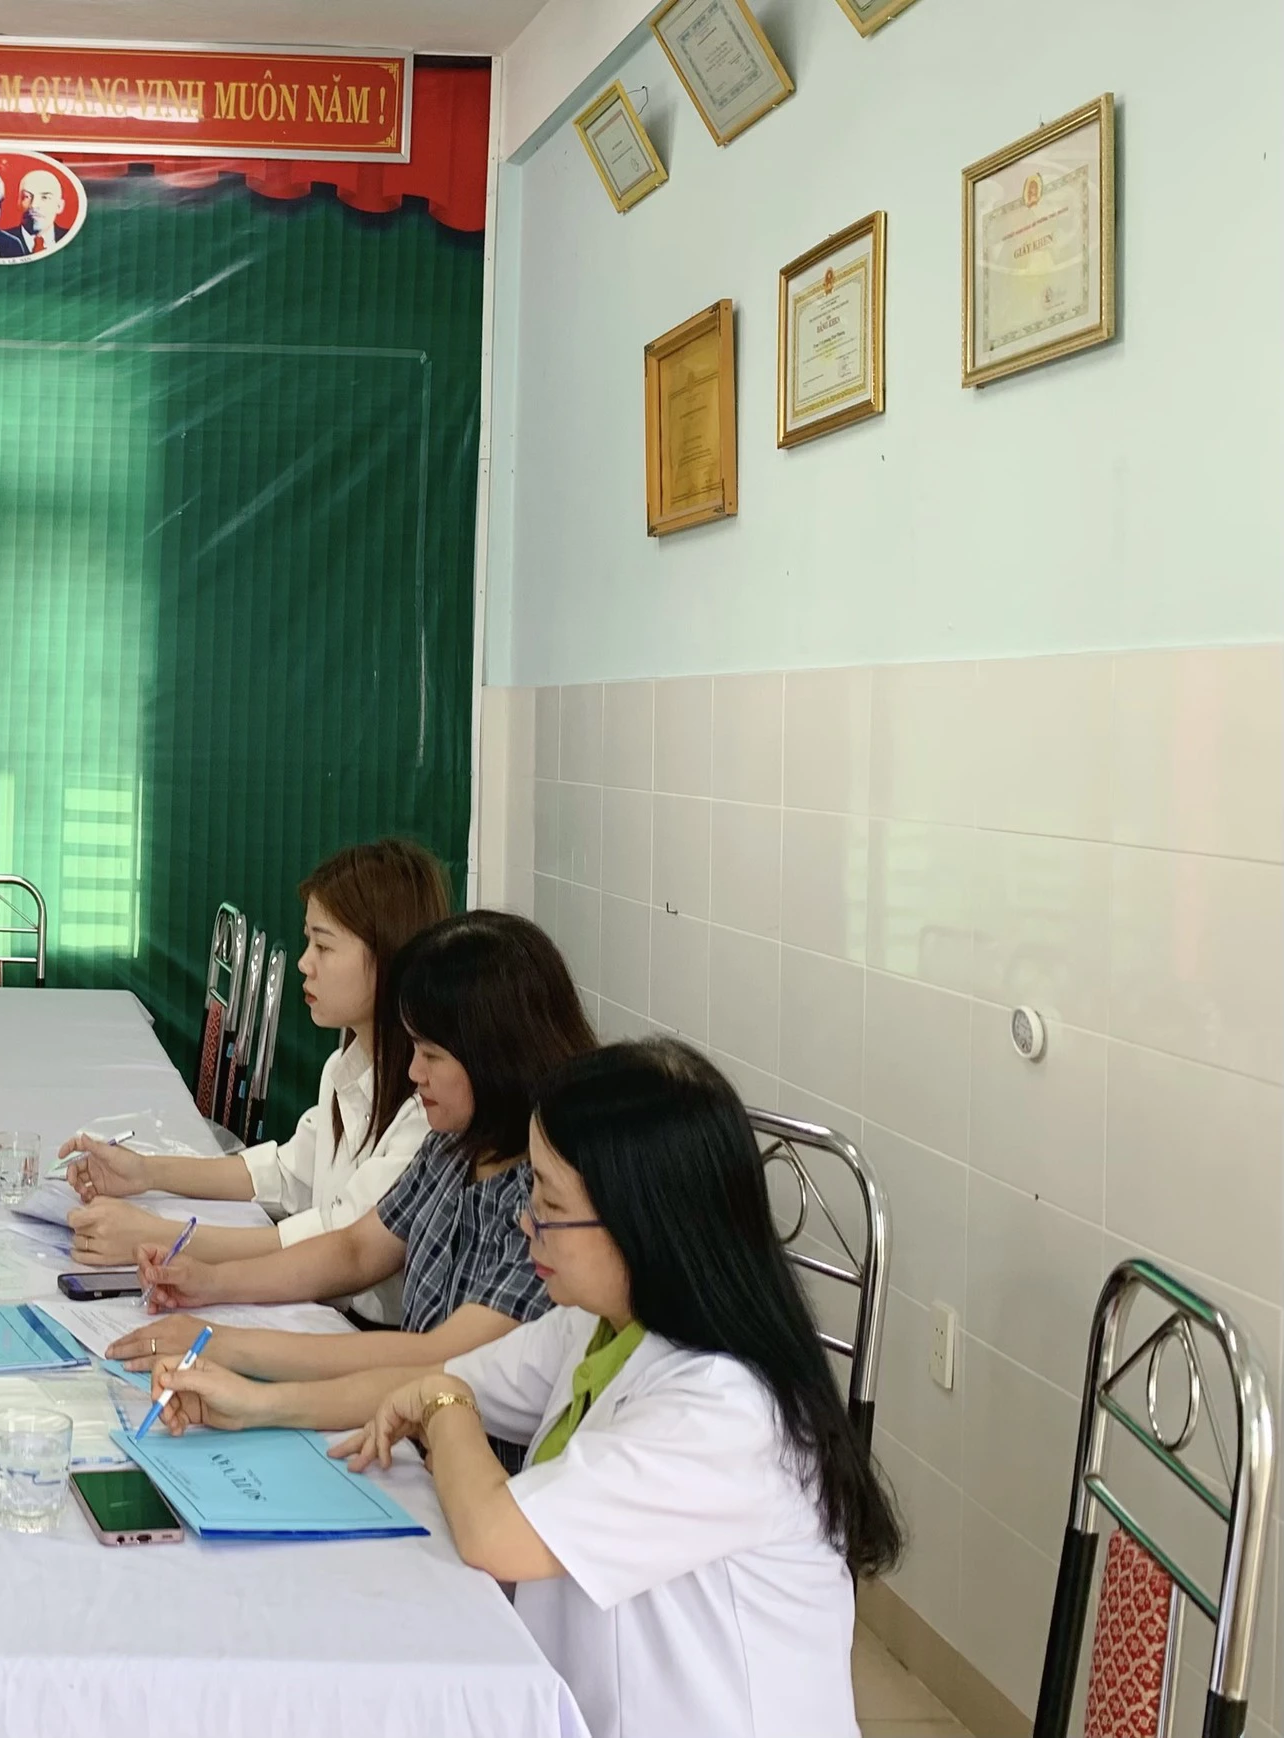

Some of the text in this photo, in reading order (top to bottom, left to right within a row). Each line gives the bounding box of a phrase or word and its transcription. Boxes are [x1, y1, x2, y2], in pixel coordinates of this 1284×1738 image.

[31, 76, 129, 124] QUANG
[136, 79, 205, 121] VINH
[213, 69, 300, 122] MUÔN
[306, 73, 371, 125] NĂM
[378, 86, 386, 125] !
